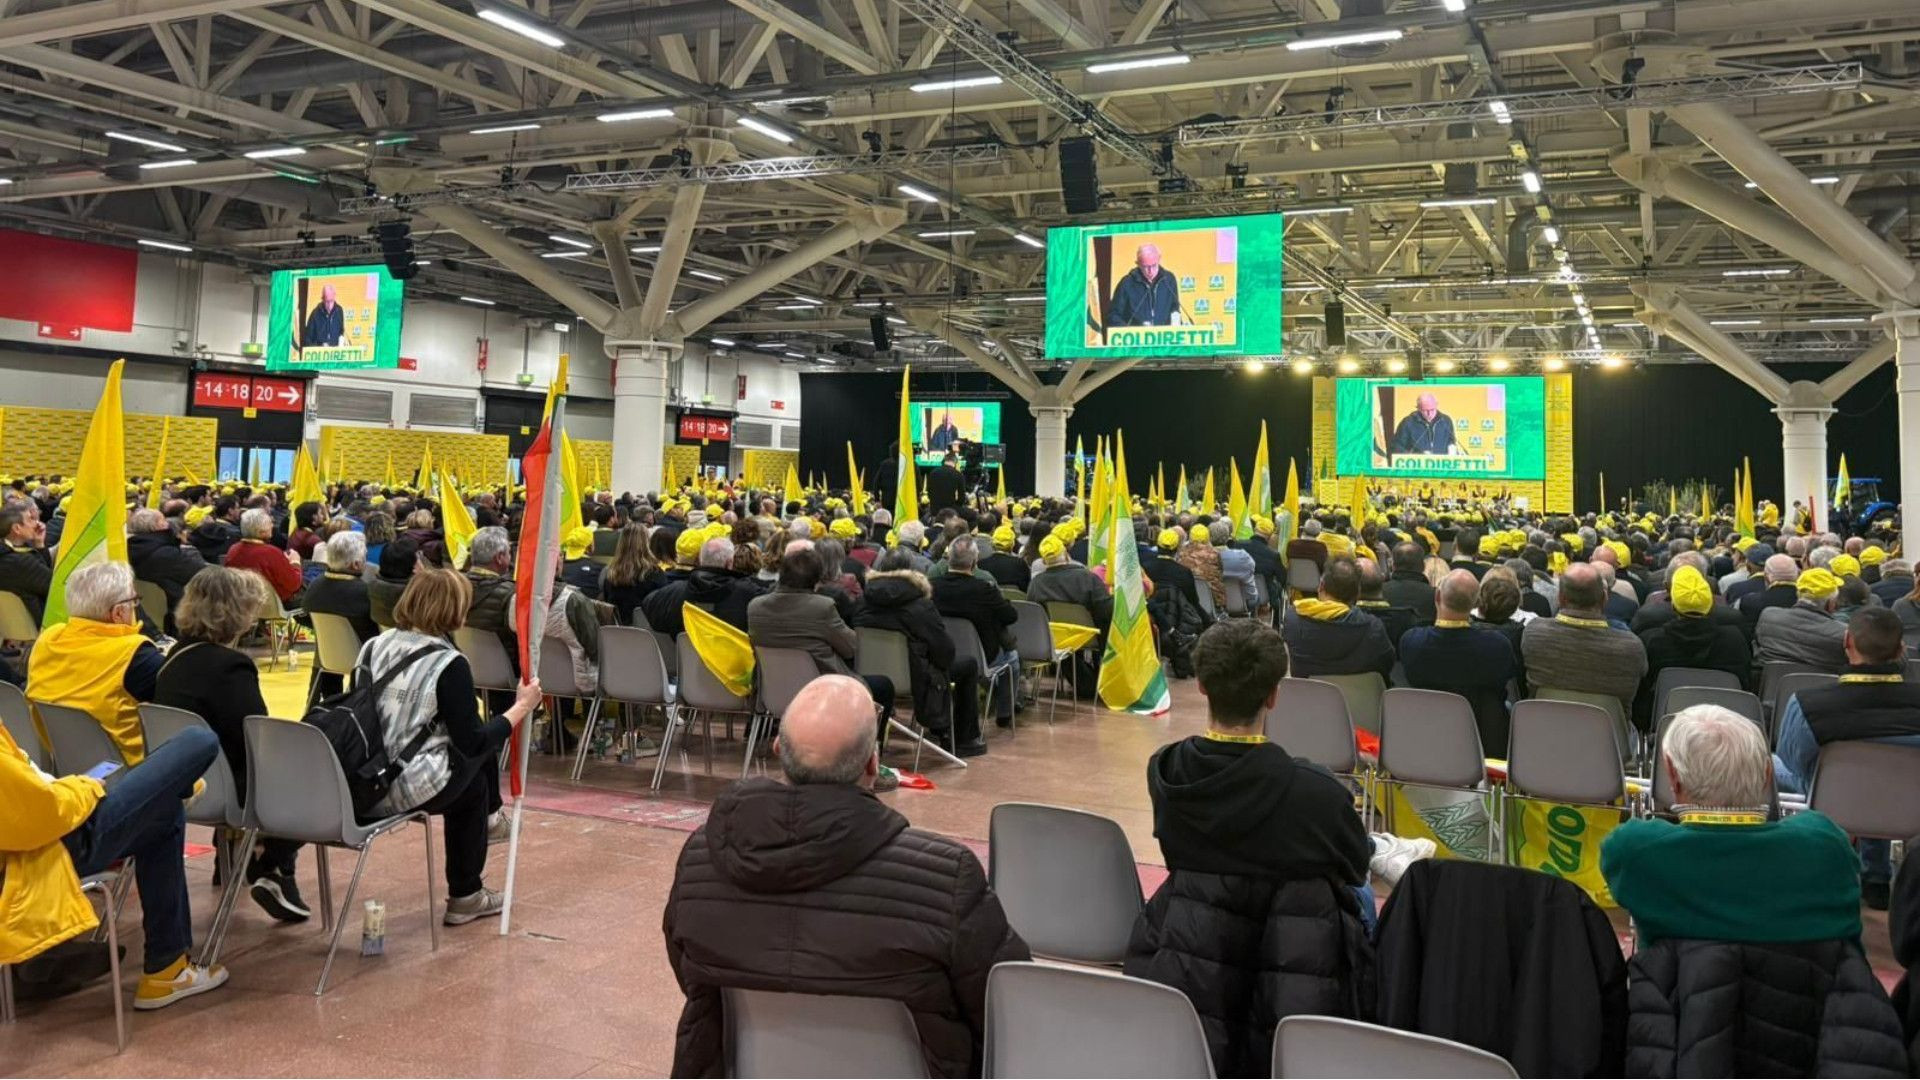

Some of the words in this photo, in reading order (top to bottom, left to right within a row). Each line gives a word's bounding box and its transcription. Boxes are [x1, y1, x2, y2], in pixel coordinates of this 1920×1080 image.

[1111, 330, 1214, 346] COLDIRETTI
[231, 383, 249, 400] 18
[256, 386, 273, 401] 20
[1395, 458, 1487, 470] COLDIRETTI
